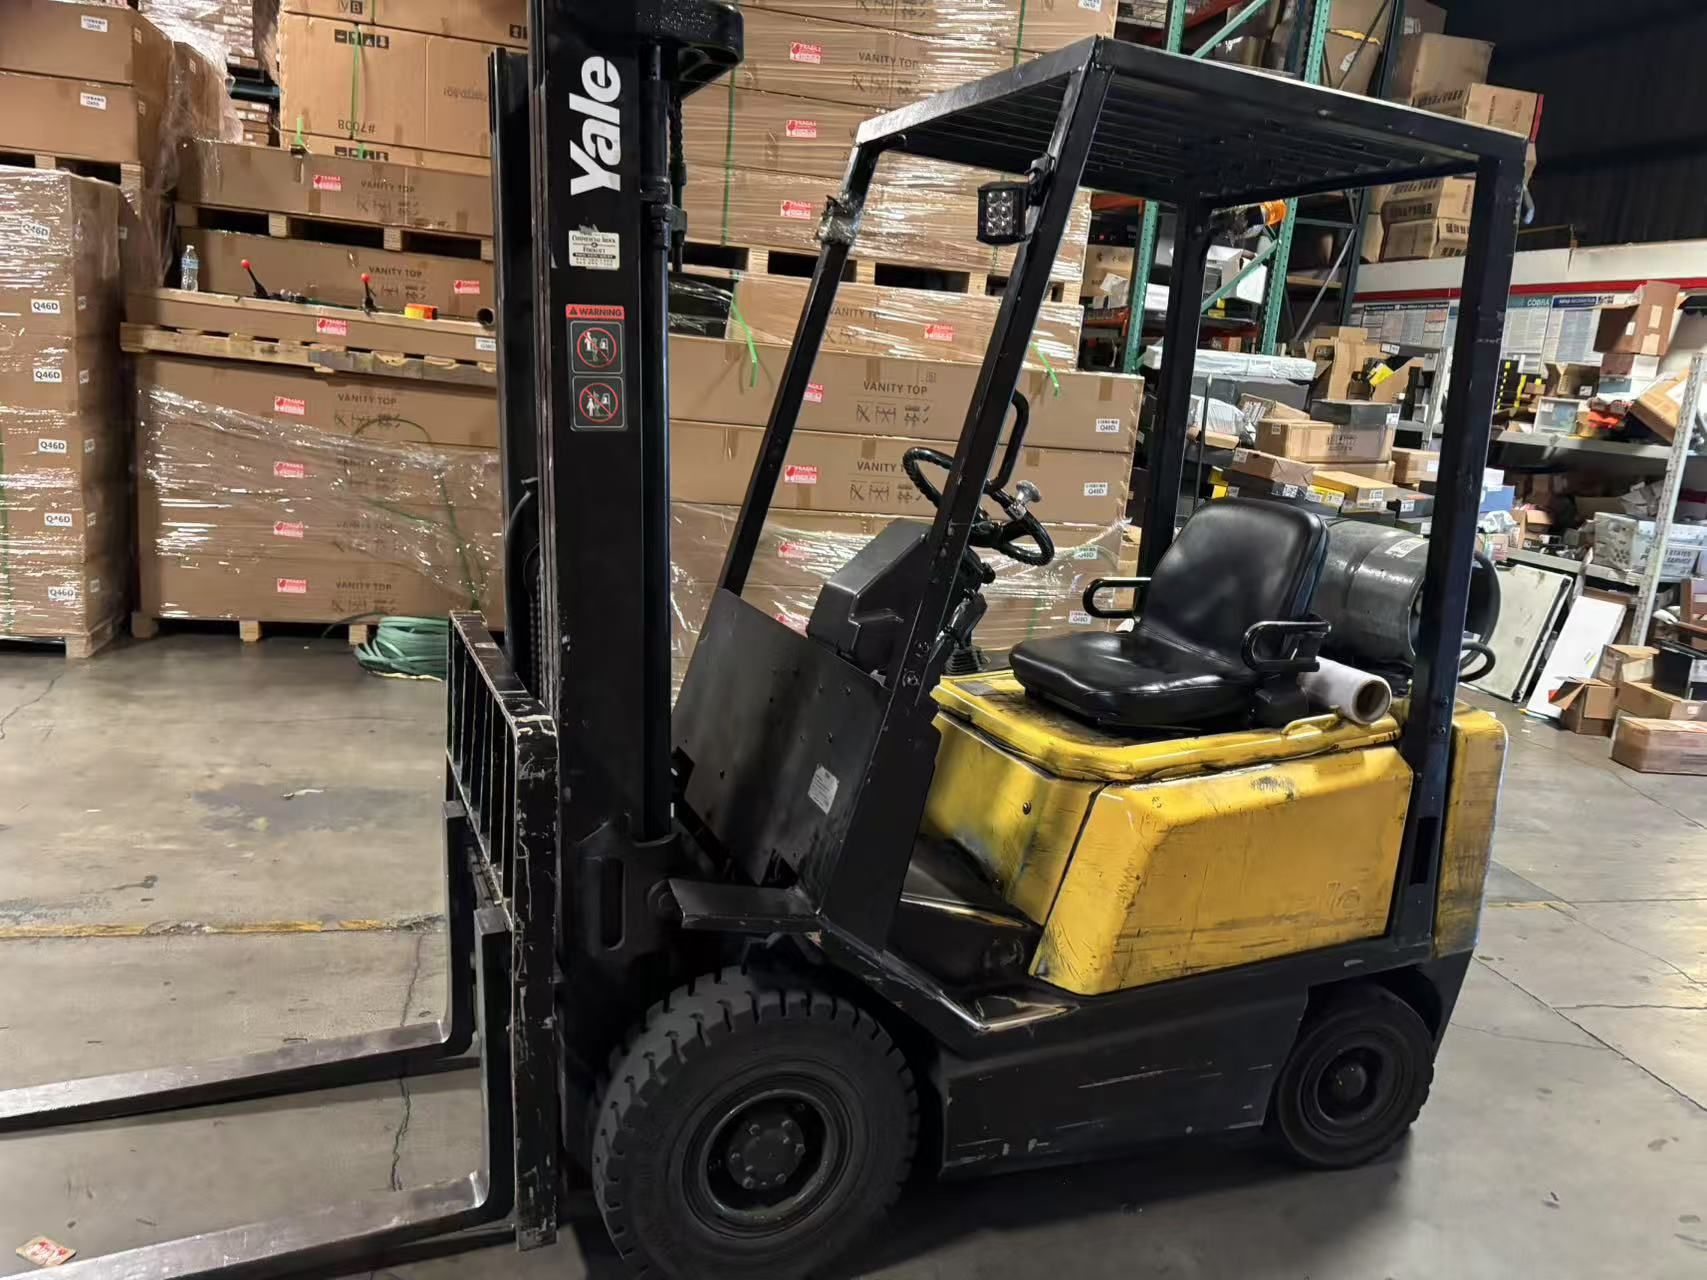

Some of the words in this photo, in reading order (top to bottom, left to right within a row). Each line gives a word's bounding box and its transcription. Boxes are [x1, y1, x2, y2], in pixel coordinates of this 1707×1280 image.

[858, 52, 896, 64] VANITY
[568, 56, 621, 196] Yale
[360, 180, 394, 191] VANITY
[368, 266, 401, 276] VANITY
[405, 270, 422, 278] TOP
[32, 302, 58, 312] Q46D
[580, 308, 622, 317] WARNING
[35, 370, 60, 380] Q46D
[863, 381, 904, 393] VANITY
[907, 384, 928, 395] TOP
[338, 393, 374, 403] VANITY
[378, 396, 397, 404] TOP
[40, 440, 65, 450] Q46D
[856, 461, 897, 473] VANITY
[336, 582, 372, 590] VANITY
